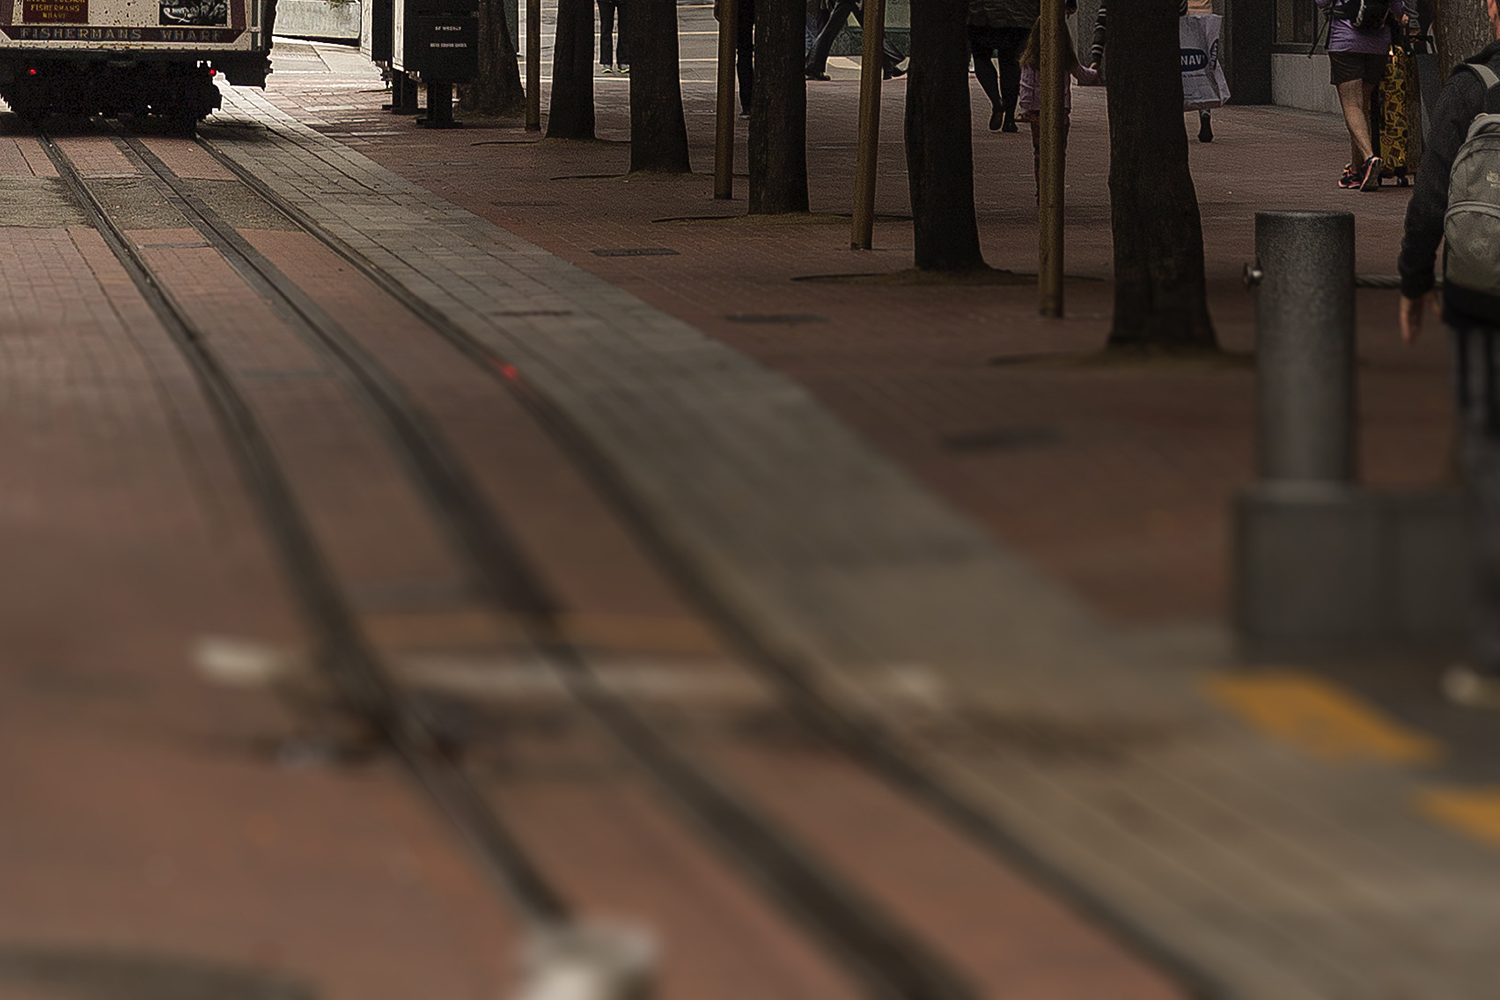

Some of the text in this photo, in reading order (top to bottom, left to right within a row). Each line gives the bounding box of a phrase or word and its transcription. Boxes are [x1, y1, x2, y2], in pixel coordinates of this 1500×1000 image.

[30, 3, 80, 12] FISHERMANS
[19, 27, 224, 41] FISHERMANS WHARF
